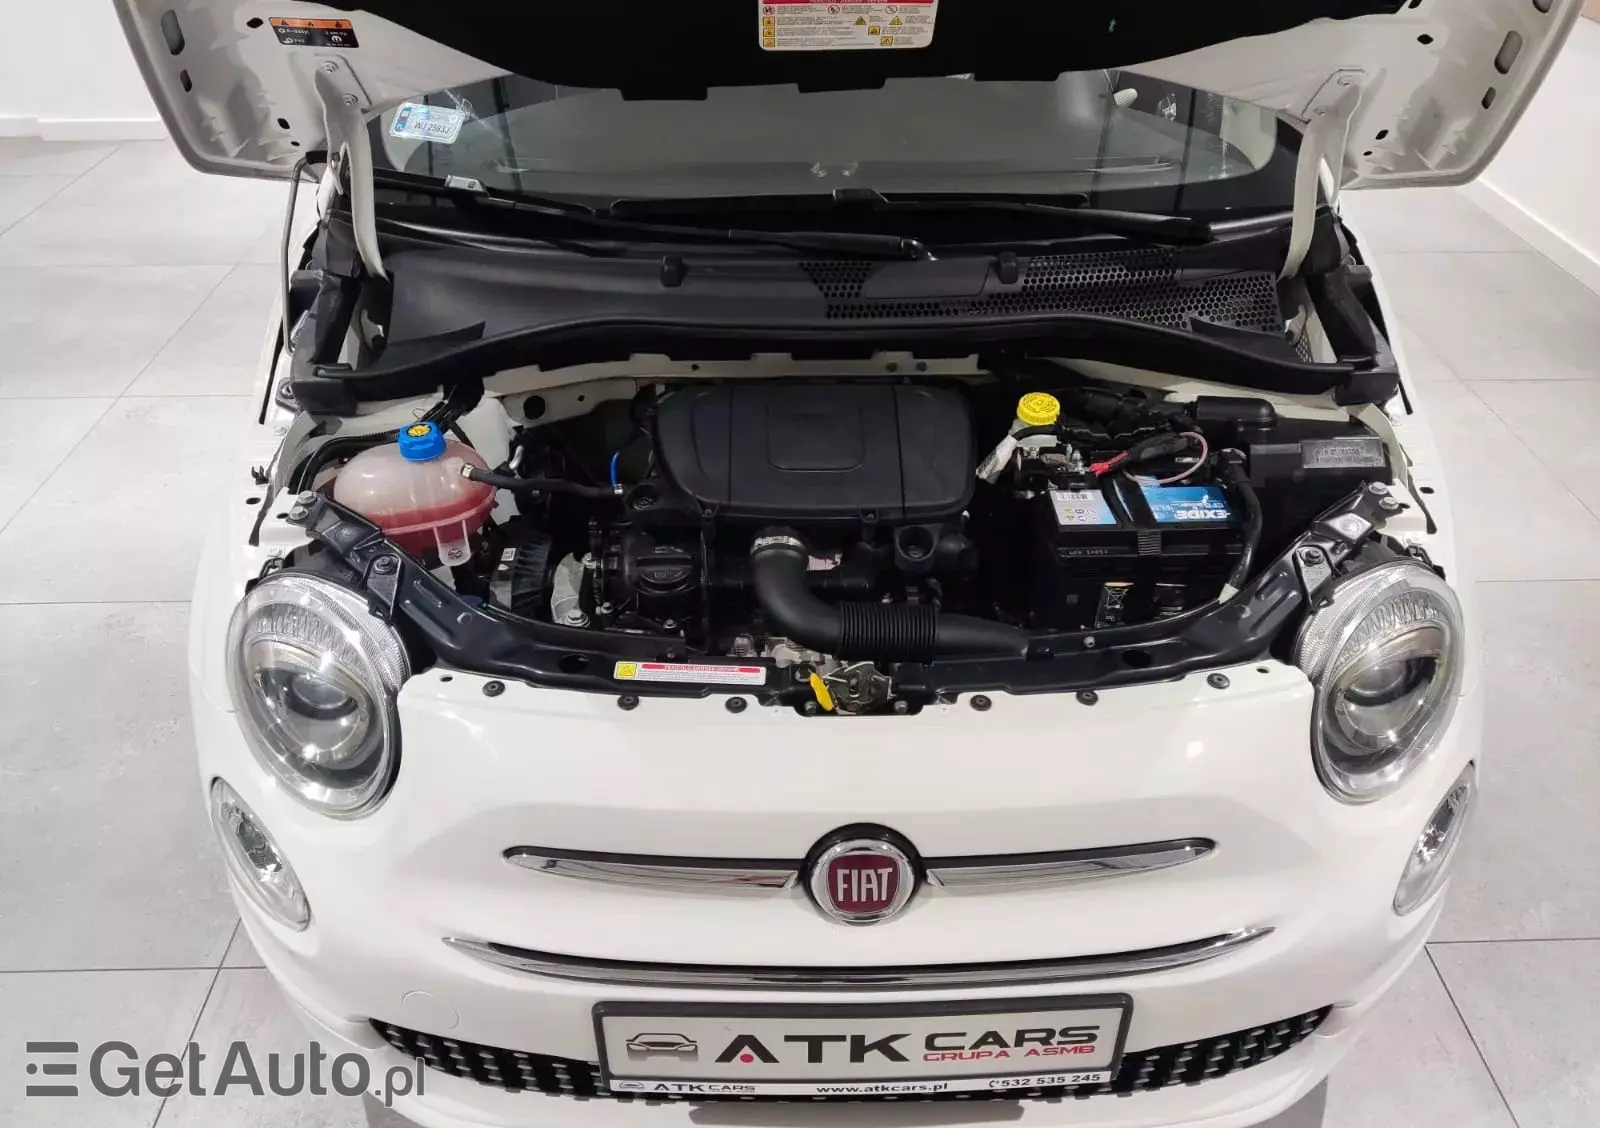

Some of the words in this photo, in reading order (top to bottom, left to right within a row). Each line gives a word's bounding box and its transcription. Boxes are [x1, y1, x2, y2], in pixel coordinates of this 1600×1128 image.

[1175, 509, 1229, 520] EXIDE
[836, 867, 894, 902] FIAT
[714, 1033, 912, 1064] ATK
[924, 1025, 1100, 1052] CARS
[923, 1049, 1010, 1062] GRUPA
[1023, 1044, 1096, 1058] ASMB
[654, 1082, 705, 1093] ATK
[708, 1084, 756, 1093] CARS
[815, 1082, 949, 1094] www.atkcars.pl
[1000, 1078, 1031, 1088] 532
[1036, 1075, 1066, 1086] 535
[1071, 1073, 1101, 1083] 245
